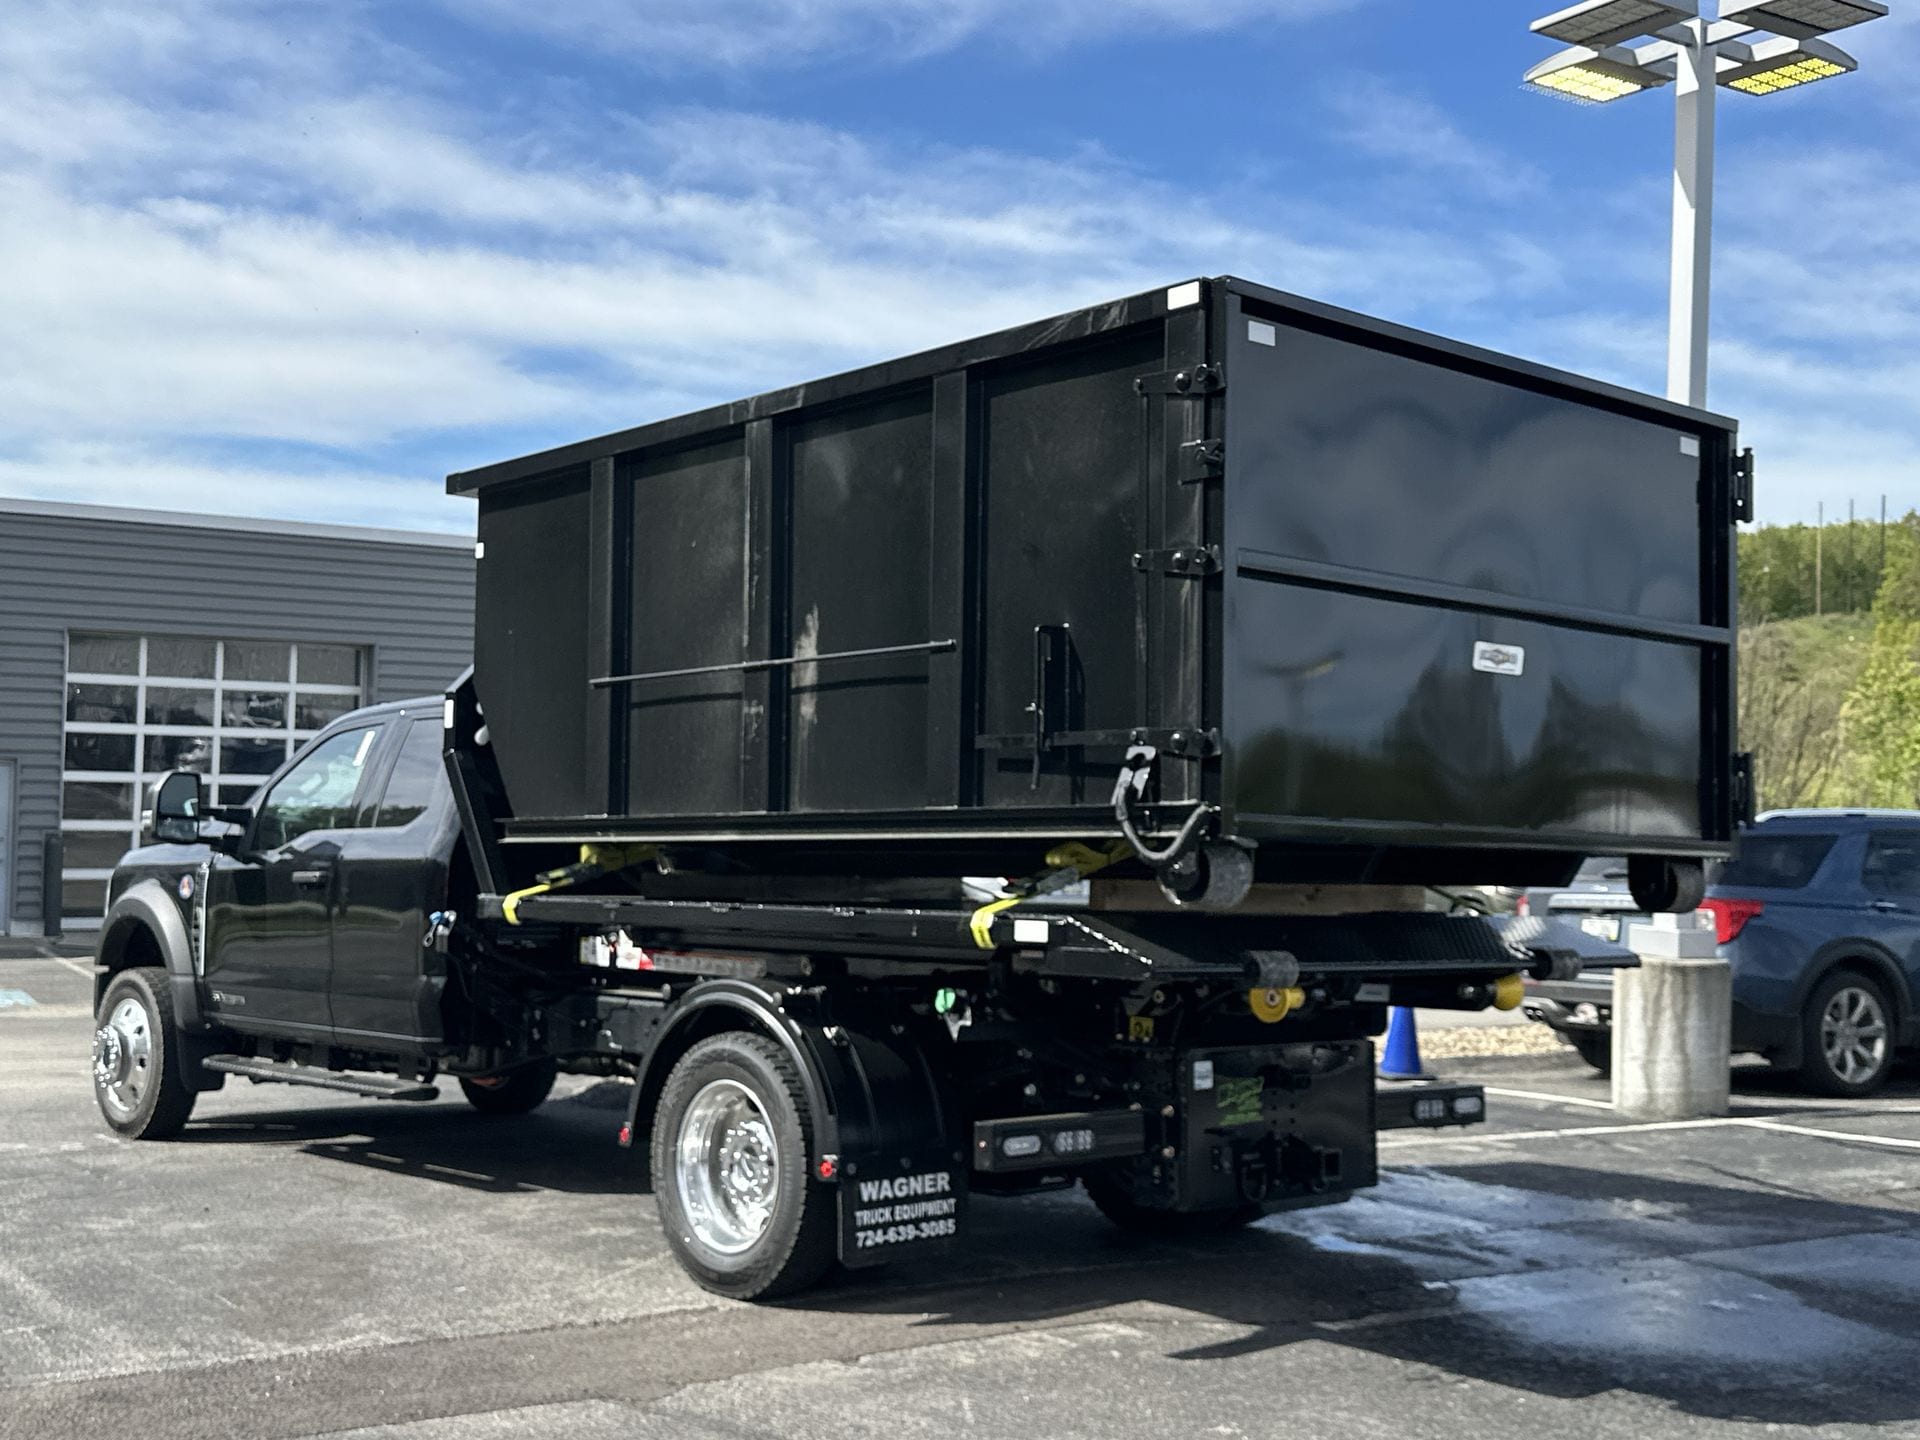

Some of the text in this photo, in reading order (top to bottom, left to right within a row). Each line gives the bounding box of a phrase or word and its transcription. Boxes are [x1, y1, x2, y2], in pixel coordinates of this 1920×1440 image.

[859, 1172, 951, 1202] WAGNER
[854, 1198, 957, 1227] TRUCK EQUIPMENT
